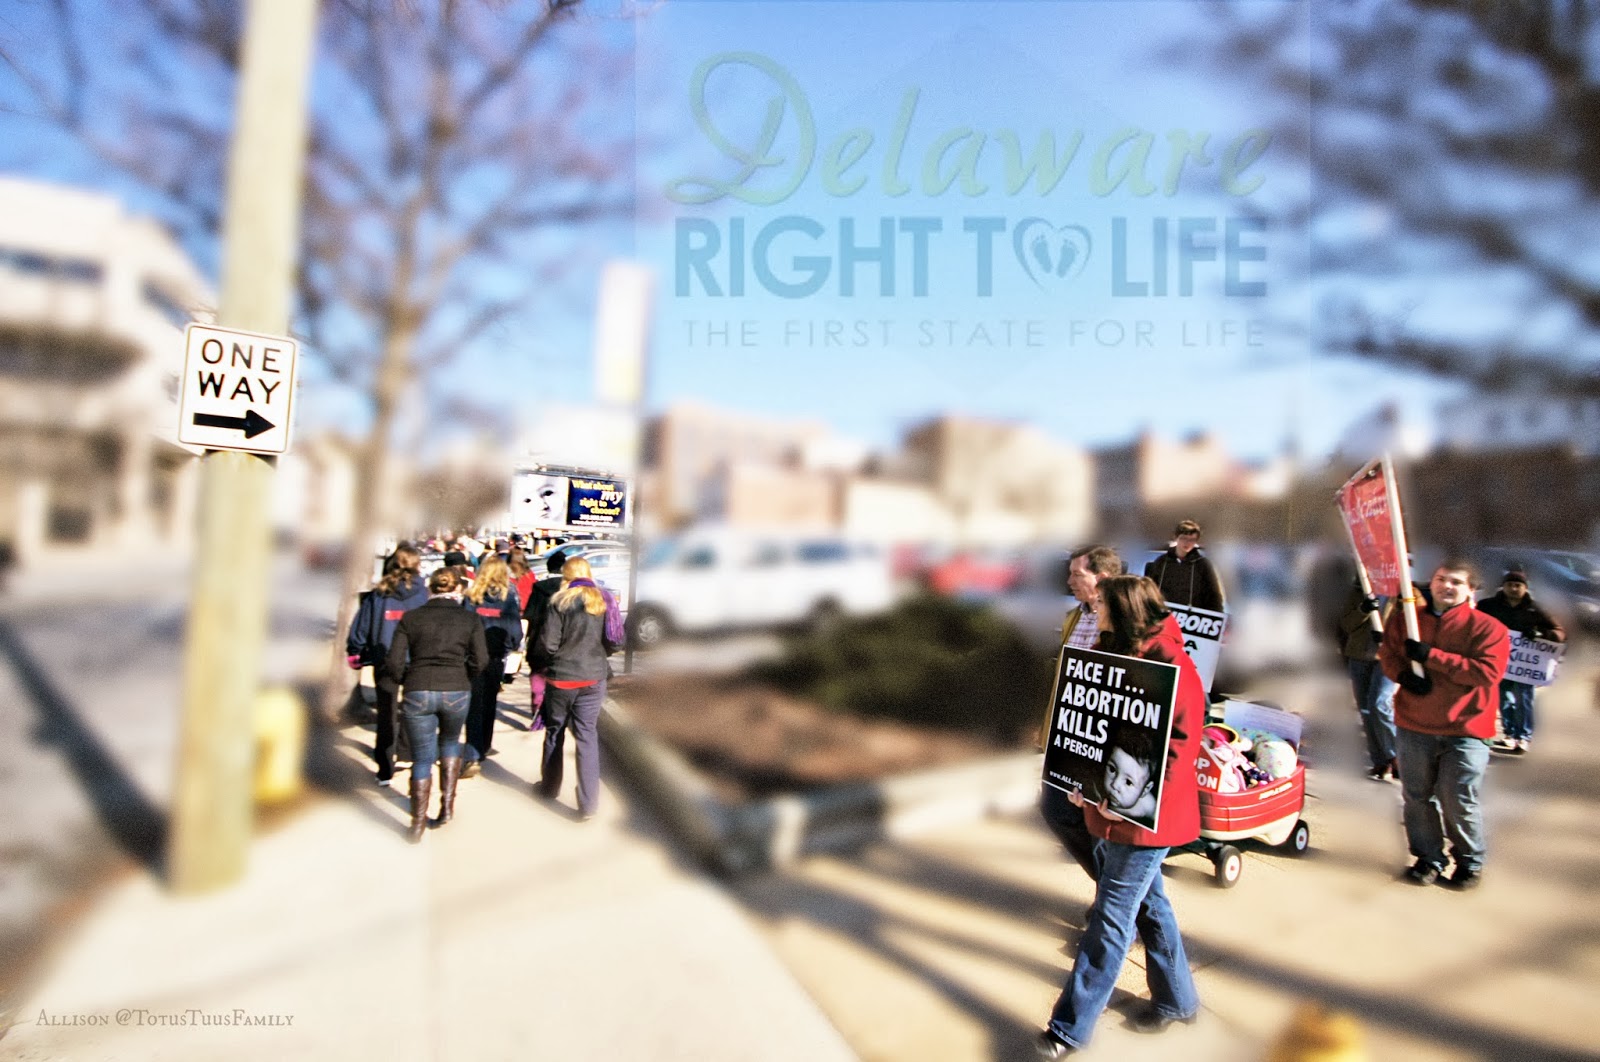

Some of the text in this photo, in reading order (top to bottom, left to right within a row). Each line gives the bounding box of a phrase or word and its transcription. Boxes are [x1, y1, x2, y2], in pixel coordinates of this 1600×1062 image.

[202, 338, 281, 374] ONE
[198, 370, 281, 404] WAY
[601, 491, 624, 505] my
[1065, 657, 1104, 684] FACE
[1060, 682, 1161, 730] ABORTION
[1056, 706, 1109, 744] KILLS
[1053, 734, 1103, 763] A PERSON
[1195, 772, 1218, 790] ON
